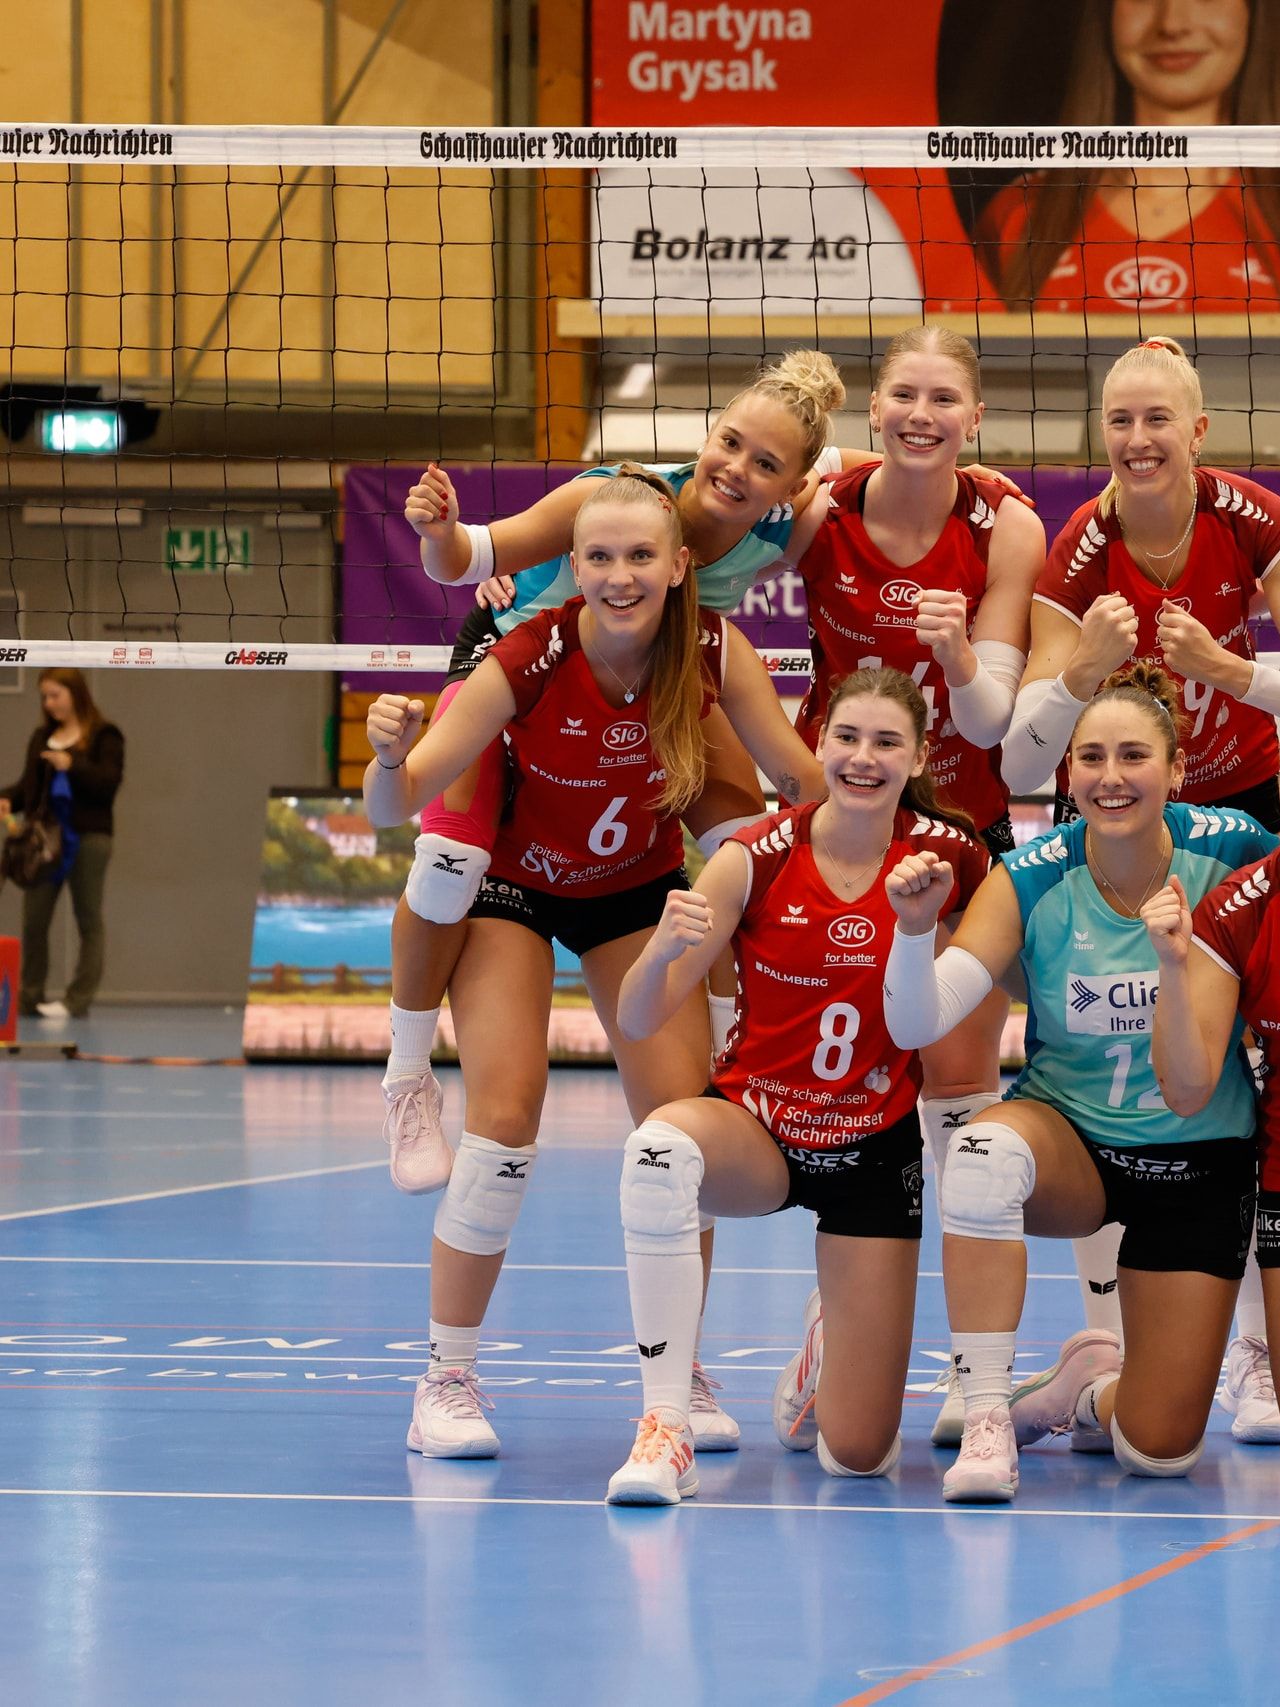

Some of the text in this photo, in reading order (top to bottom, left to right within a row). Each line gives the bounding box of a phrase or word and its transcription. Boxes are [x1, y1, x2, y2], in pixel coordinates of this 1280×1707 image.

[628, 2, 812, 50] Martyna
[628, 49, 777, 101] Grysak
[0, 128, 173, 158] user Nachrichten
[420, 131, 677, 162] Schaffhauser Nachrichten
[927, 131, 1188, 162] Schaffhauser Nachrichten
[631, 229, 858, 262] Bolanz AG
[1117, 266, 1174, 297] SIG
[888, 585, 917, 602] SIG
[823, 610, 876, 645] PALMBERG
[875, 612, 918, 626] for bette
[225, 648, 288, 665] GASSER
[762, 656, 811, 672] SSER
[560, 727, 587, 737] erima
[609, 727, 639, 744] SIG
[599, 753, 647, 765] for better
[1184, 754, 1242, 786] hrichten
[539, 770, 607, 788] PALMBERG
[588, 797, 628, 856] 6
[530, 842, 573, 865] spitäler
[481, 876, 524, 900] ken
[780, 915, 809, 925] erima
[835, 922, 867, 939] SIG
[824, 952, 876, 964] for better
[764, 965, 829, 988] PALMBERG
[1110, 1017, 1146, 1032] Ihre
[811, 1002, 860, 1081] 8
[747, 1074, 790, 1096] spitäler
[783, 1106, 884, 1128] Schaffhauser
[778, 1121, 877, 1145] Nachrichte
